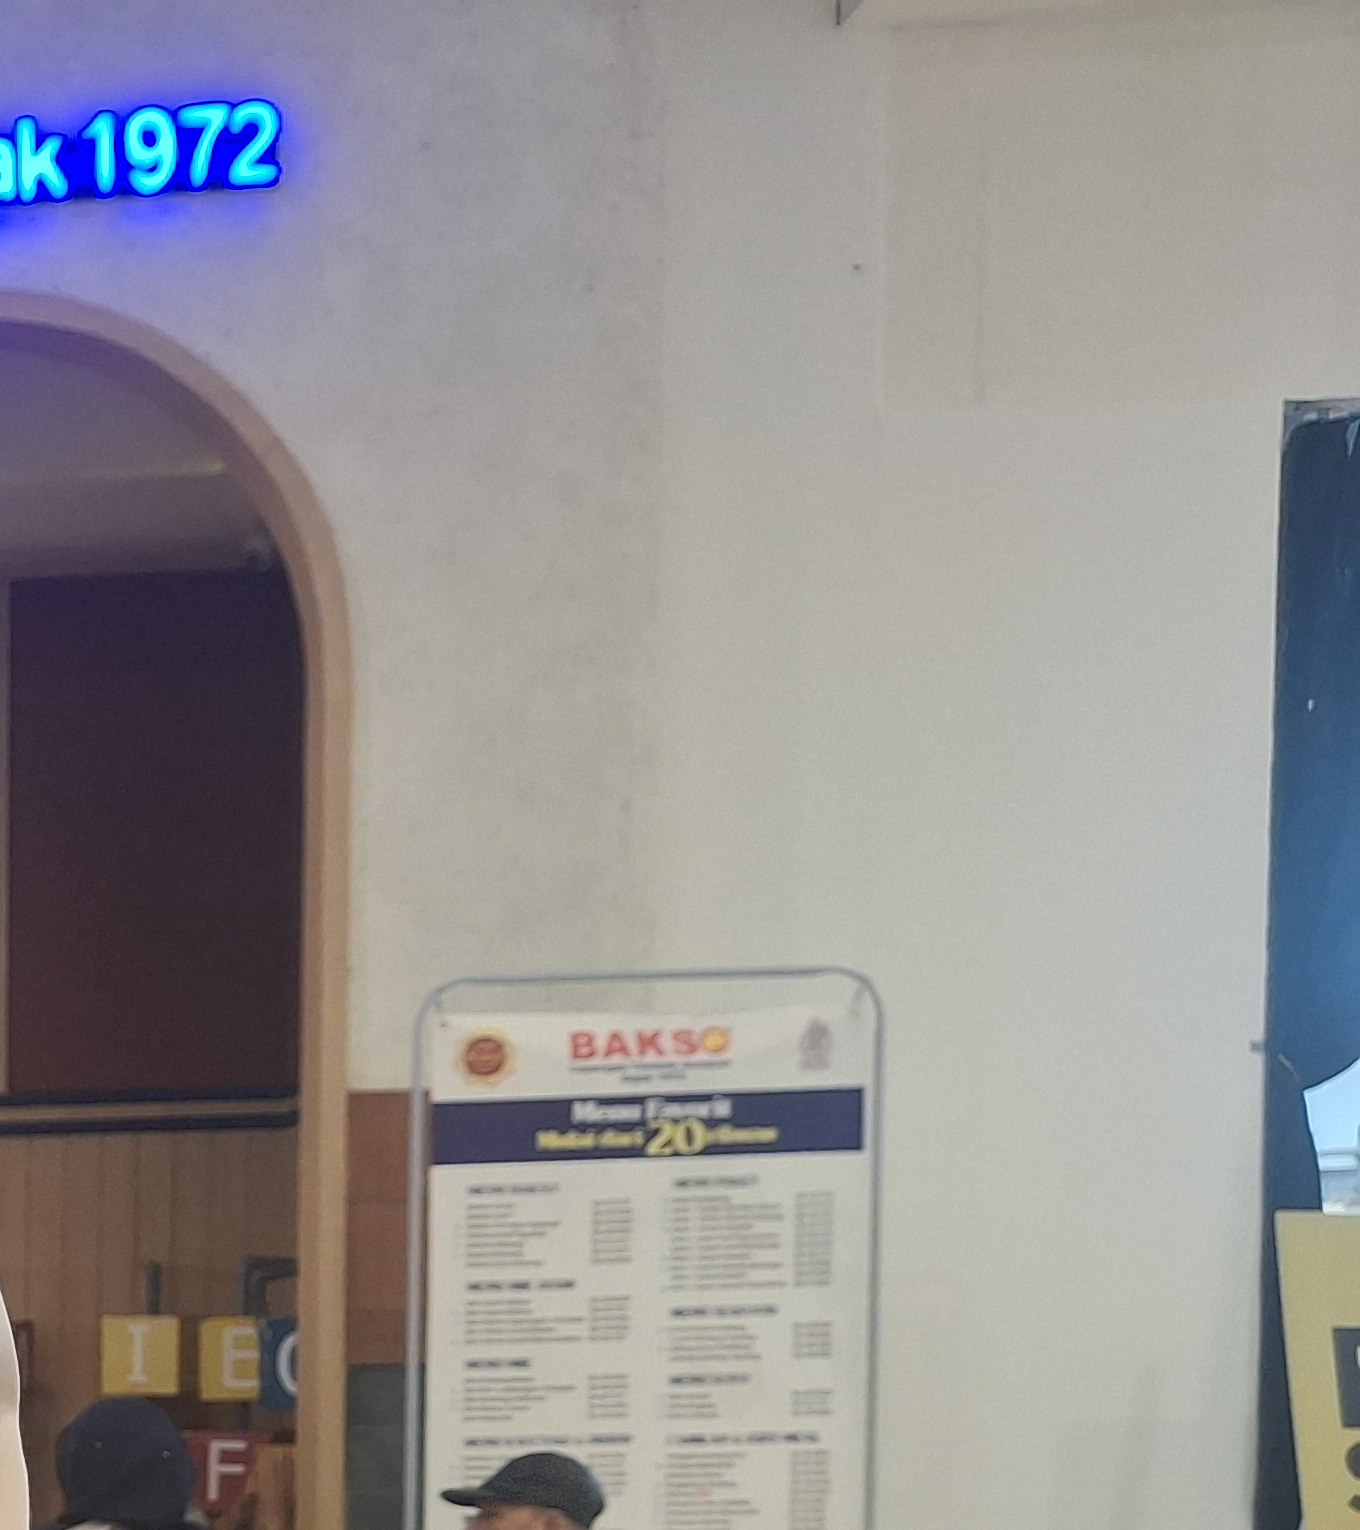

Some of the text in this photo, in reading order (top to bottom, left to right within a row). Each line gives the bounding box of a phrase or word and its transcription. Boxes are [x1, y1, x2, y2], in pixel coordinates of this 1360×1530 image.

[80, 98, 280, 198] 1972
[645, 1117, 707, 1157] 20
[222, 1326, 260, 1389] E
[206, 1438, 247, 1502] F
